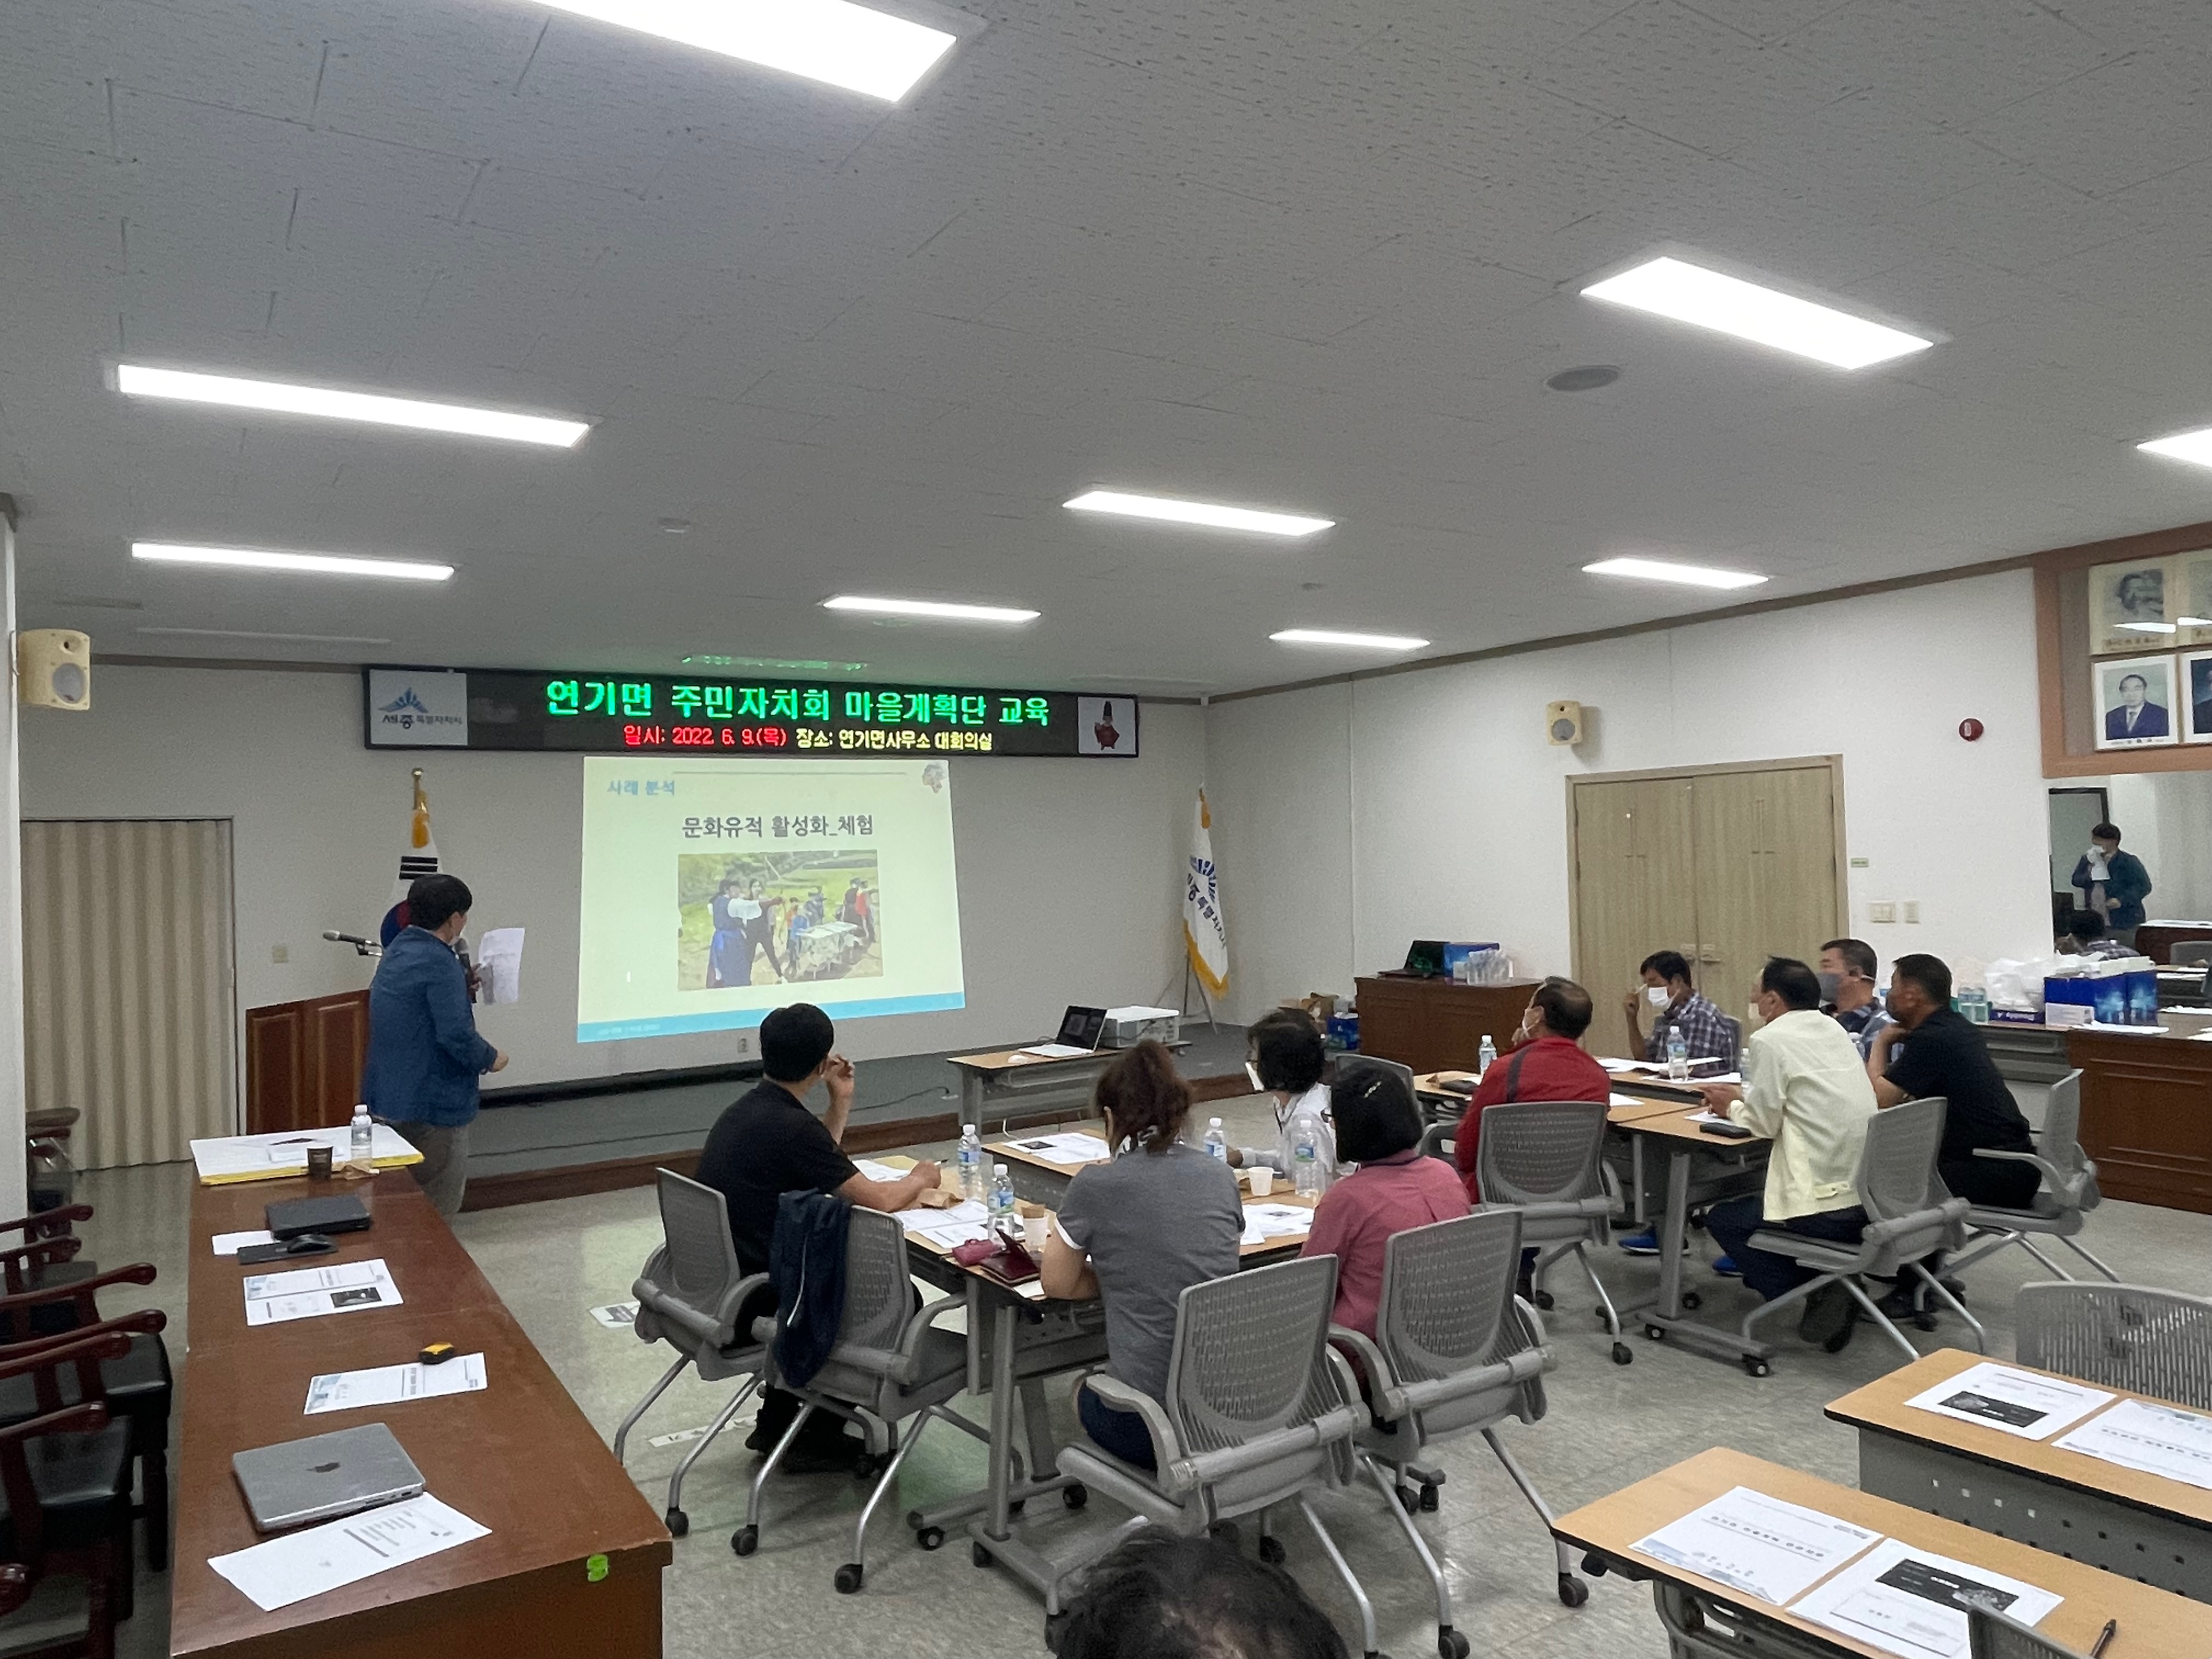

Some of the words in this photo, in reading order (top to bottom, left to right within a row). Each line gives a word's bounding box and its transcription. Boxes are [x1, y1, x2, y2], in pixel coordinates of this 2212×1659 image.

[547, 680, 651, 715] 연기면
[671, 685, 830, 721] 주민자치회
[845, 691, 986, 725] 마을계획단
[999, 697, 1048, 726] 교육
[623, 725, 664, 746] 일시:
[796, 729, 833, 749] 장소:
[839, 729, 930, 749] 연기면사무소
[934, 732, 992, 751] 대회의실
[682, 816, 763, 838] 문화유적
